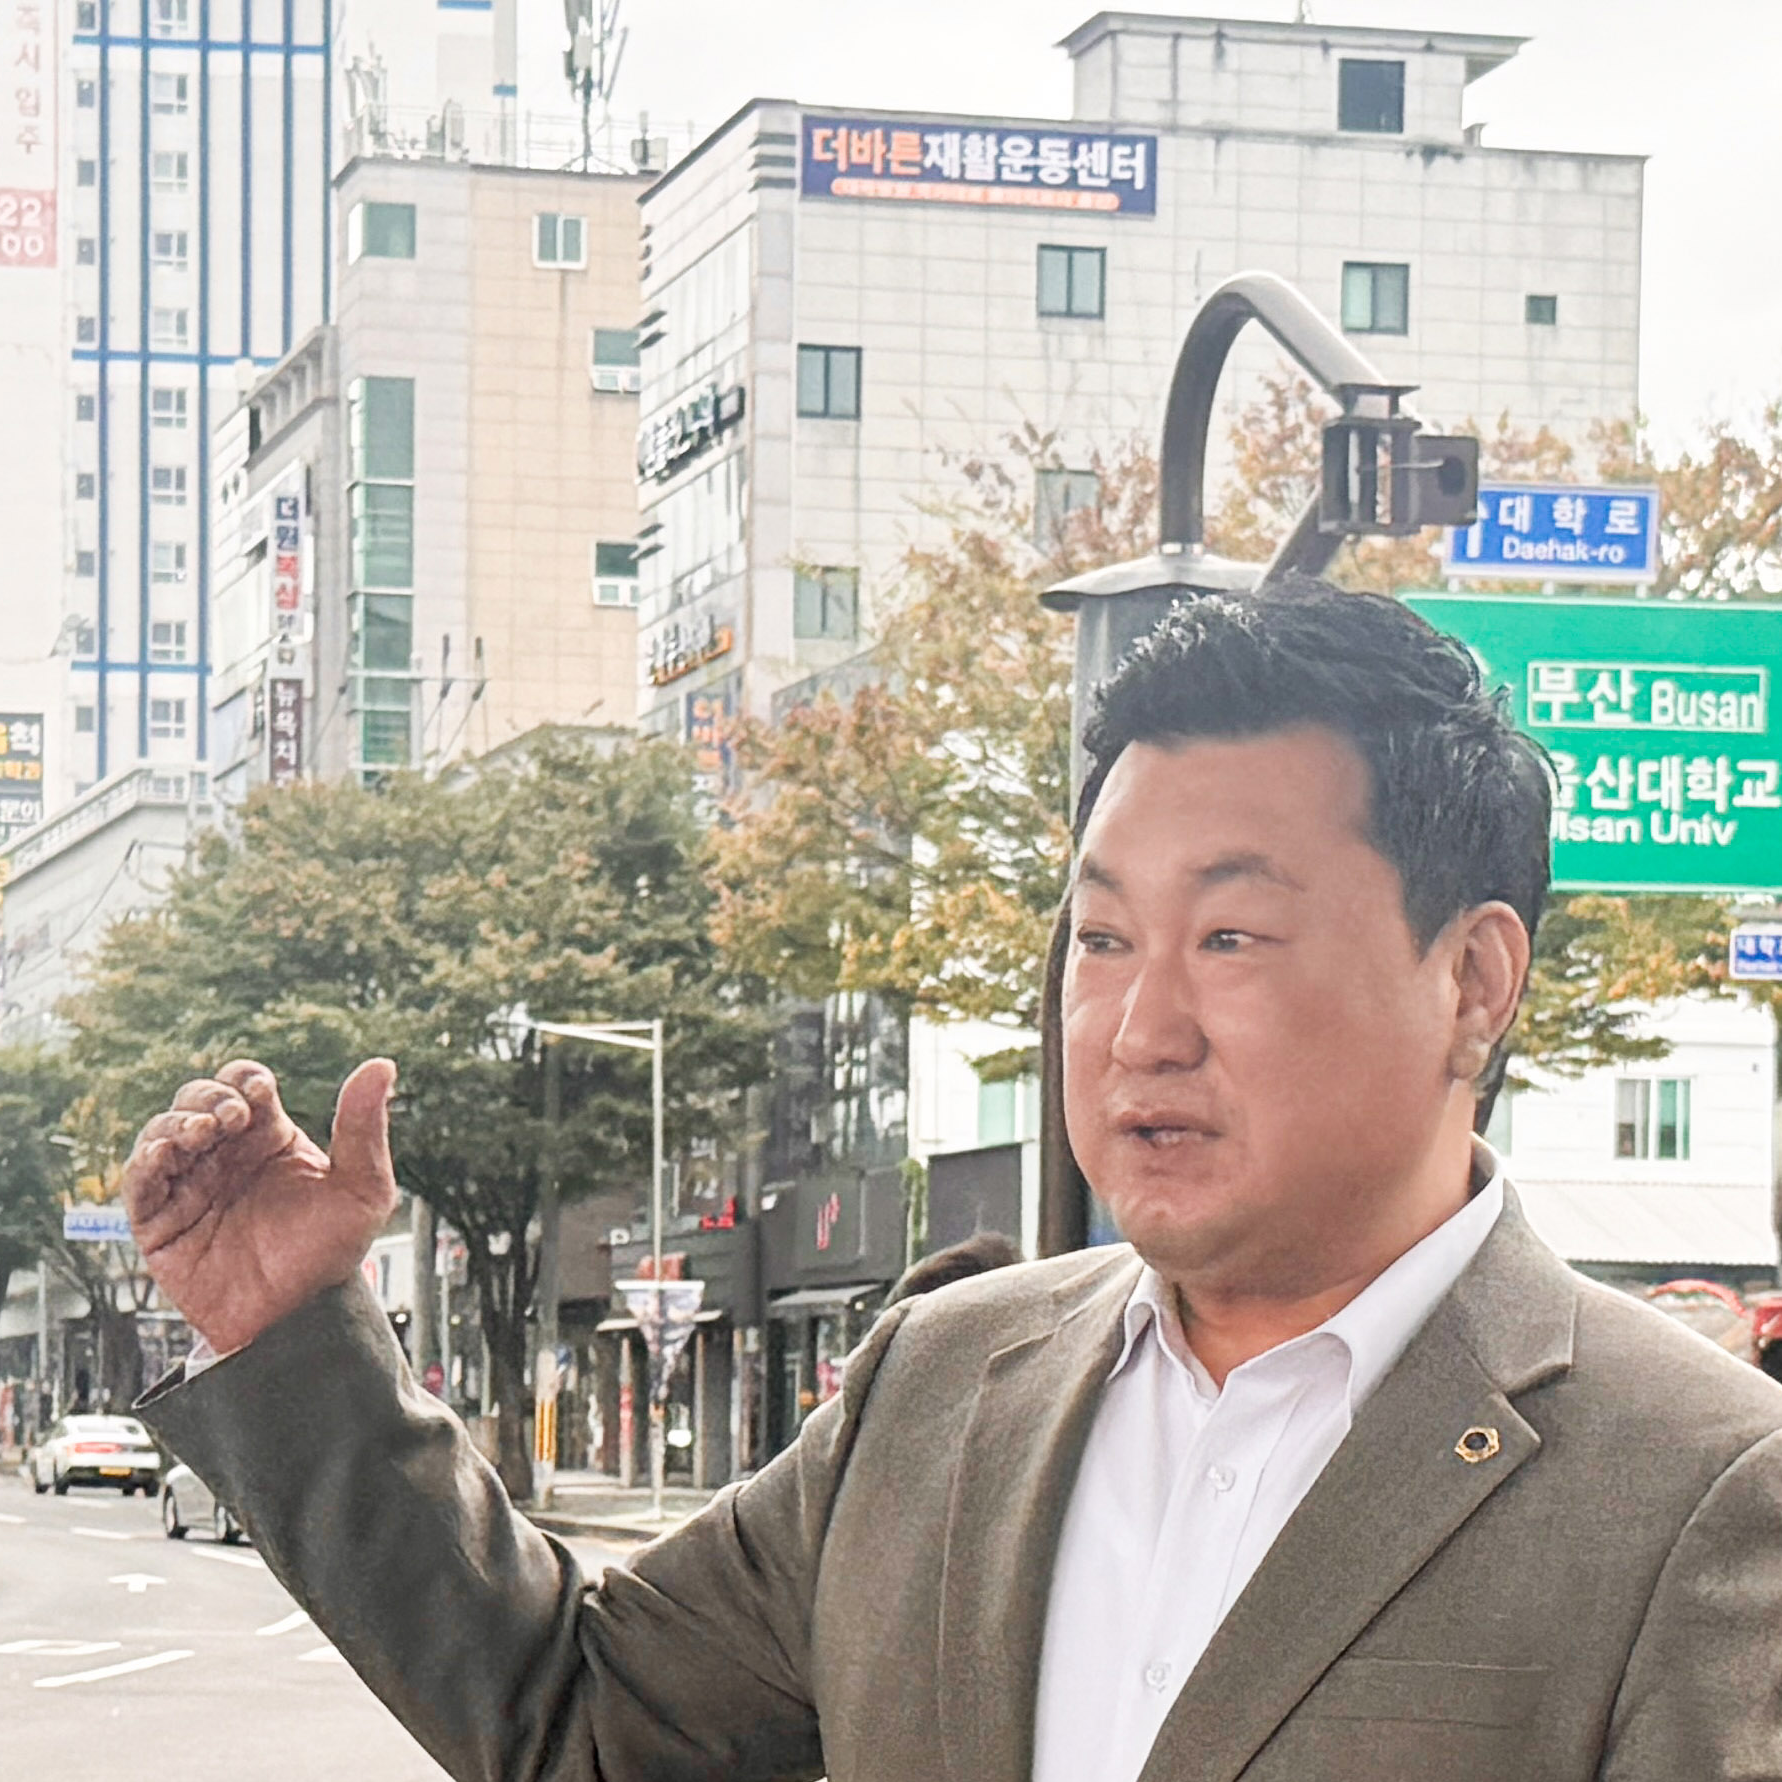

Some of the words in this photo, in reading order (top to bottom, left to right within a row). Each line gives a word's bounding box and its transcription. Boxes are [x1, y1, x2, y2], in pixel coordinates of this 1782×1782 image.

[1498, 494, 1641, 536] 대학로
[1502, 535, 1626, 564] Daehak-ro
[1531, 666, 1638, 724] 부산
[1650, 678, 1761, 729] Busan
[1650, 811, 1737, 846] Univ
